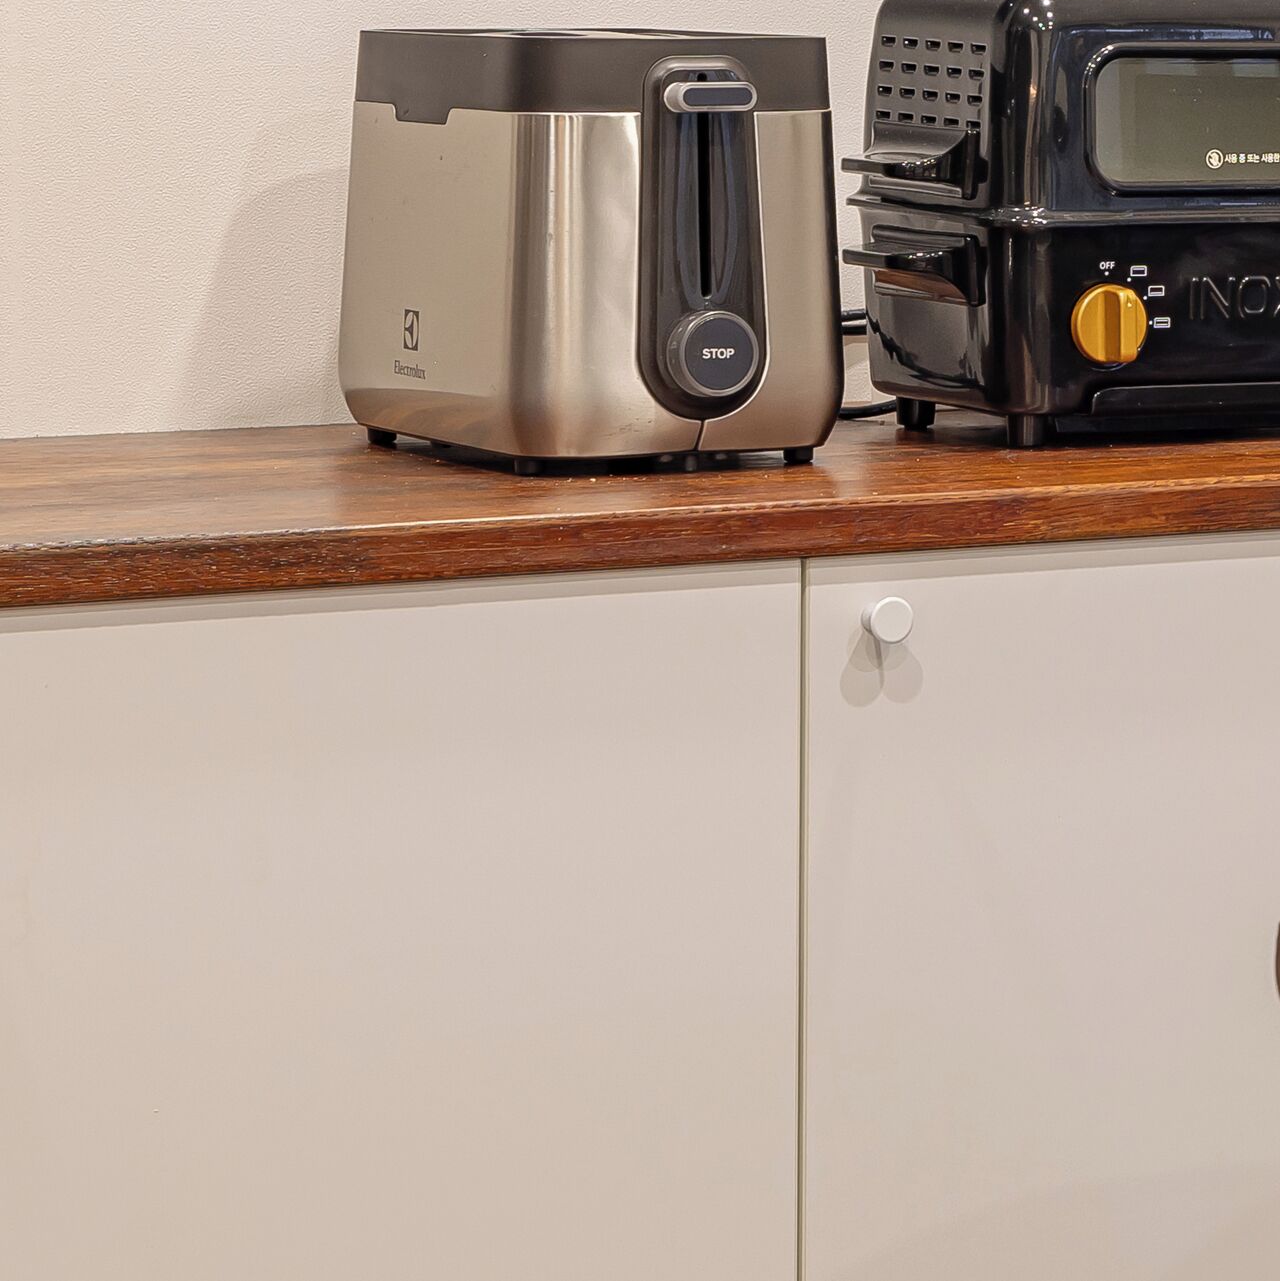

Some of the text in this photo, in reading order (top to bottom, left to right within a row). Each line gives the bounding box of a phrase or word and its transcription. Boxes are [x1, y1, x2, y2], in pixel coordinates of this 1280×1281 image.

[1224, 152, 1237, 163] 사용
[1247, 152, 1260, 163] 또는
[1261, 152, 1280, 163] 사용한
[1099, 261, 1115, 270] OFF
[702, 348, 735, 359] STOP
[394, 359, 426, 380] Electrolux
